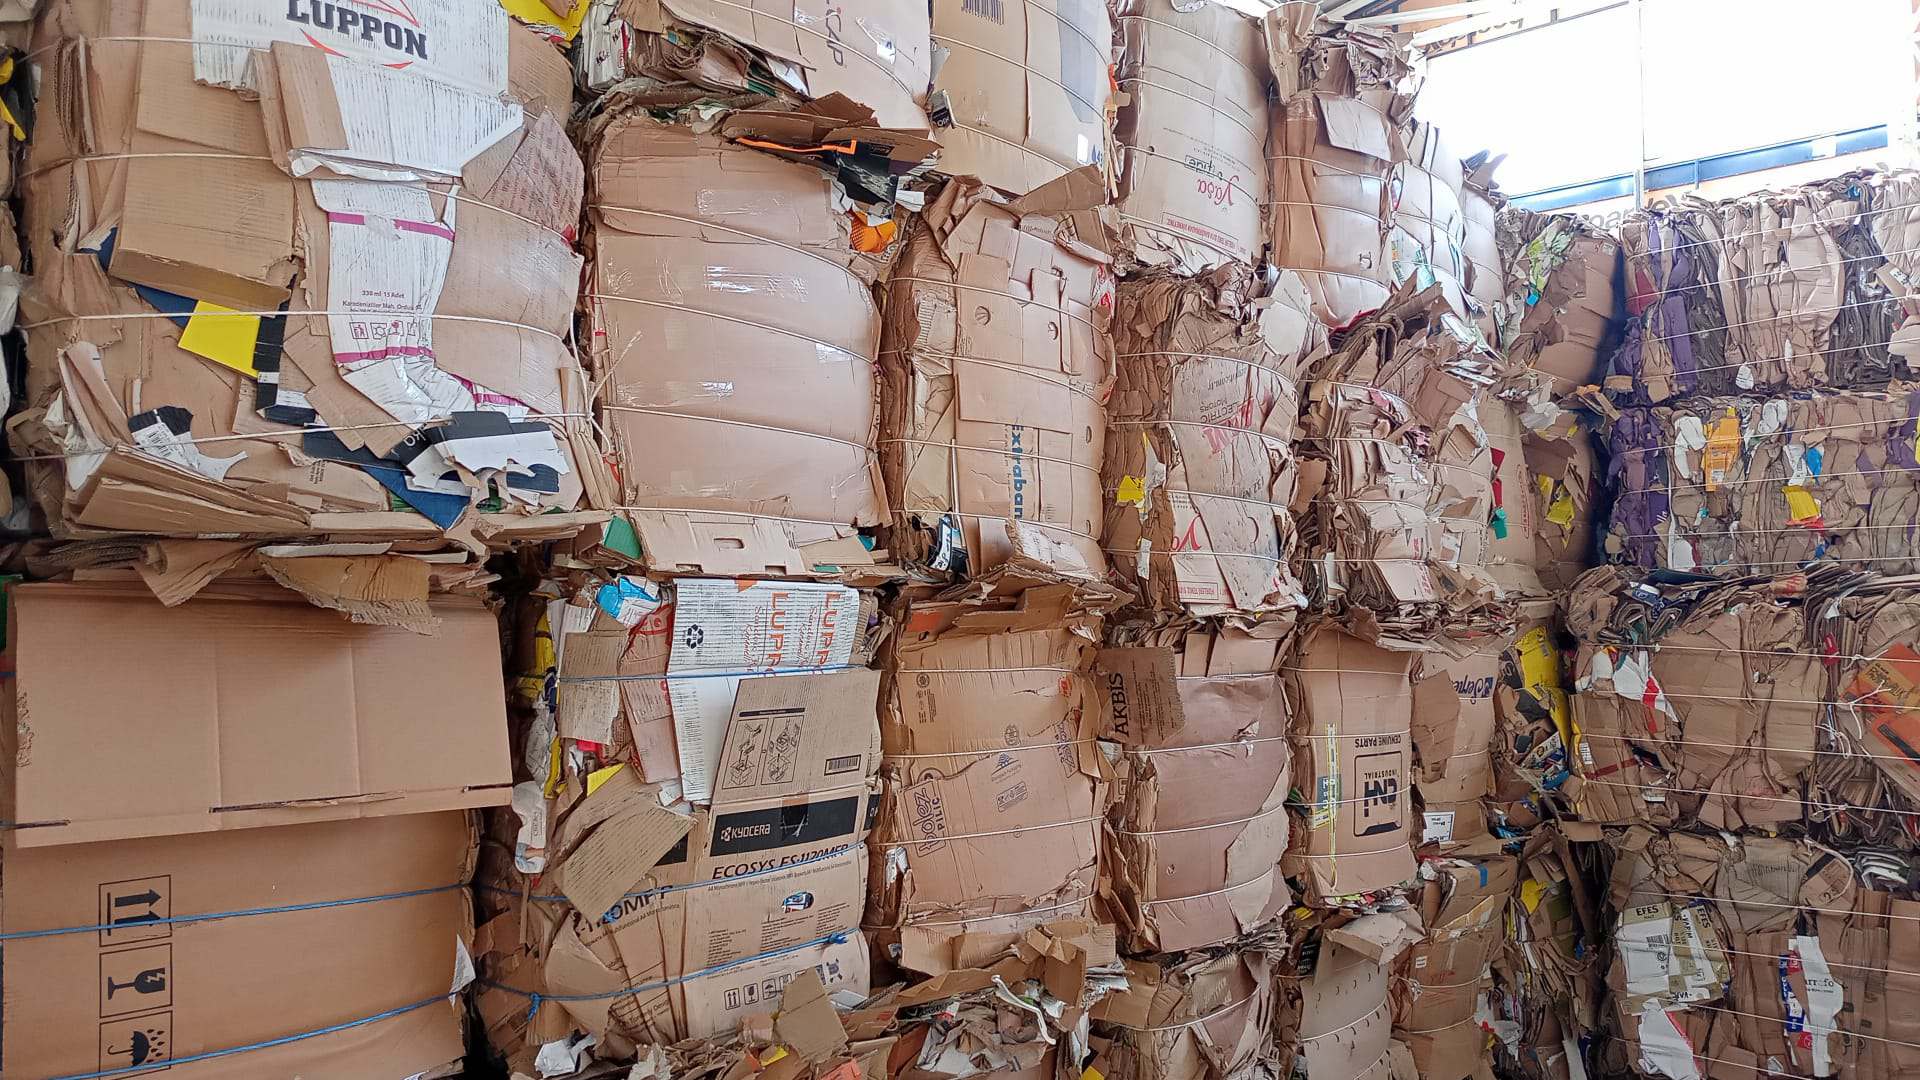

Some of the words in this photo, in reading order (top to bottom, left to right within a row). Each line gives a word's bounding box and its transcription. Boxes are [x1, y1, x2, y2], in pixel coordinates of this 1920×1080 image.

[286, 0, 428, 60] LUPPON
[1354, 737, 1378, 749] PARTS
[1364, 768, 1400, 780] INDUSTRIAL
[913, 788, 939, 851] bolez
[731, 823, 771, 839] KYOCERA
[711, 858, 776, 880] ECOSYS
[1635, 905, 1659, 916] EFES
[1696, 907, 1711, 929] EFES
